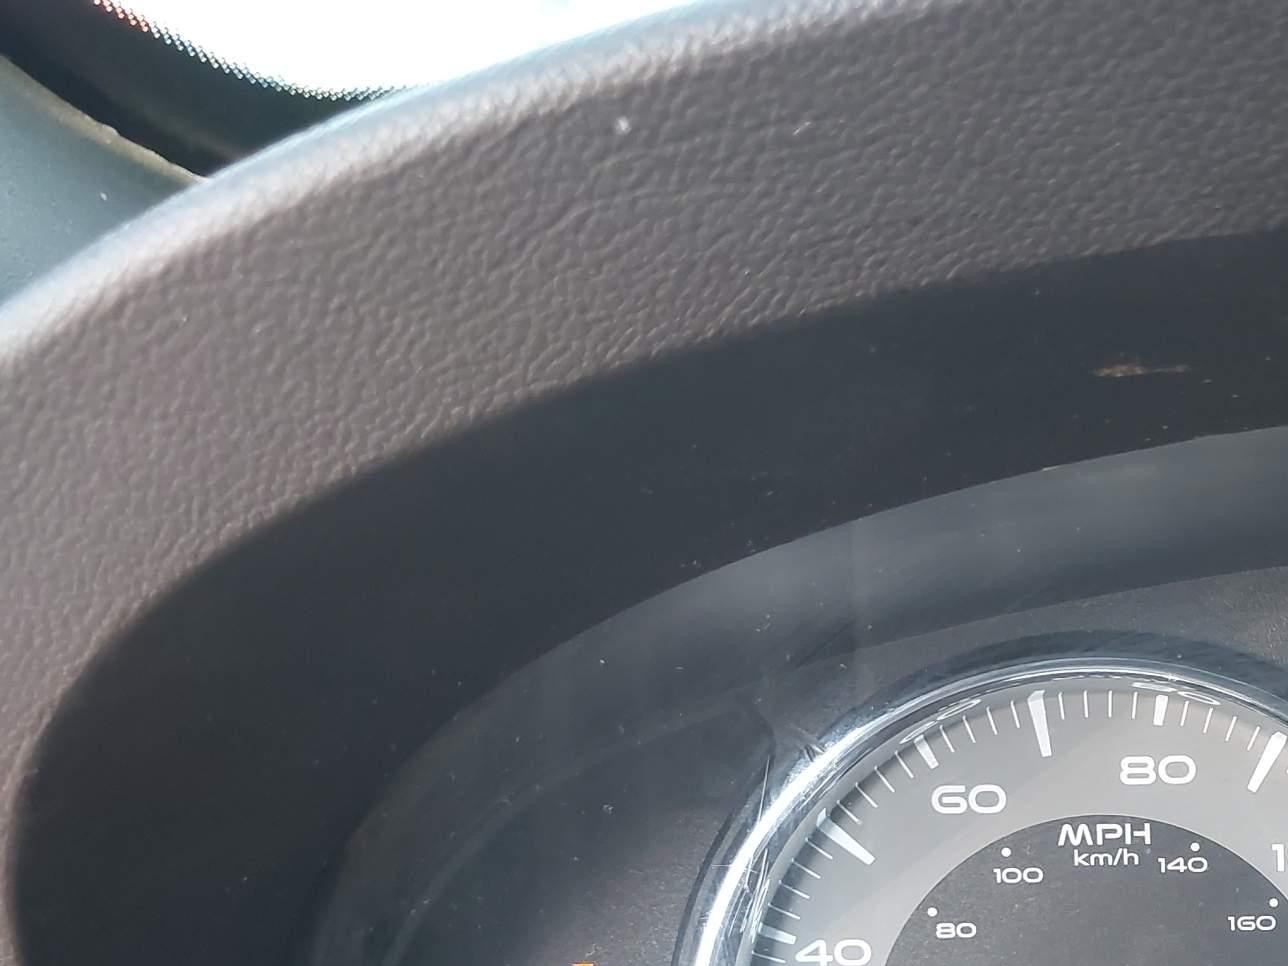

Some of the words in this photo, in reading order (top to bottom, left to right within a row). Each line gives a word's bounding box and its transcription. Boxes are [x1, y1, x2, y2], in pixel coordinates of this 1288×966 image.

[1120, 755, 1197, 785] 80
[930, 785, 1007, 814] 60
[1058, 823, 1152, 846] MPH
[1073, 847, 1140, 869] km/h
[1158, 856, 1209, 874] 140
[993, 866, 1044, 885] 100
[935, 921, 977, 939] 80
[1228, 914, 1277, 932] 160
[795, 939, 872, 966] 40
